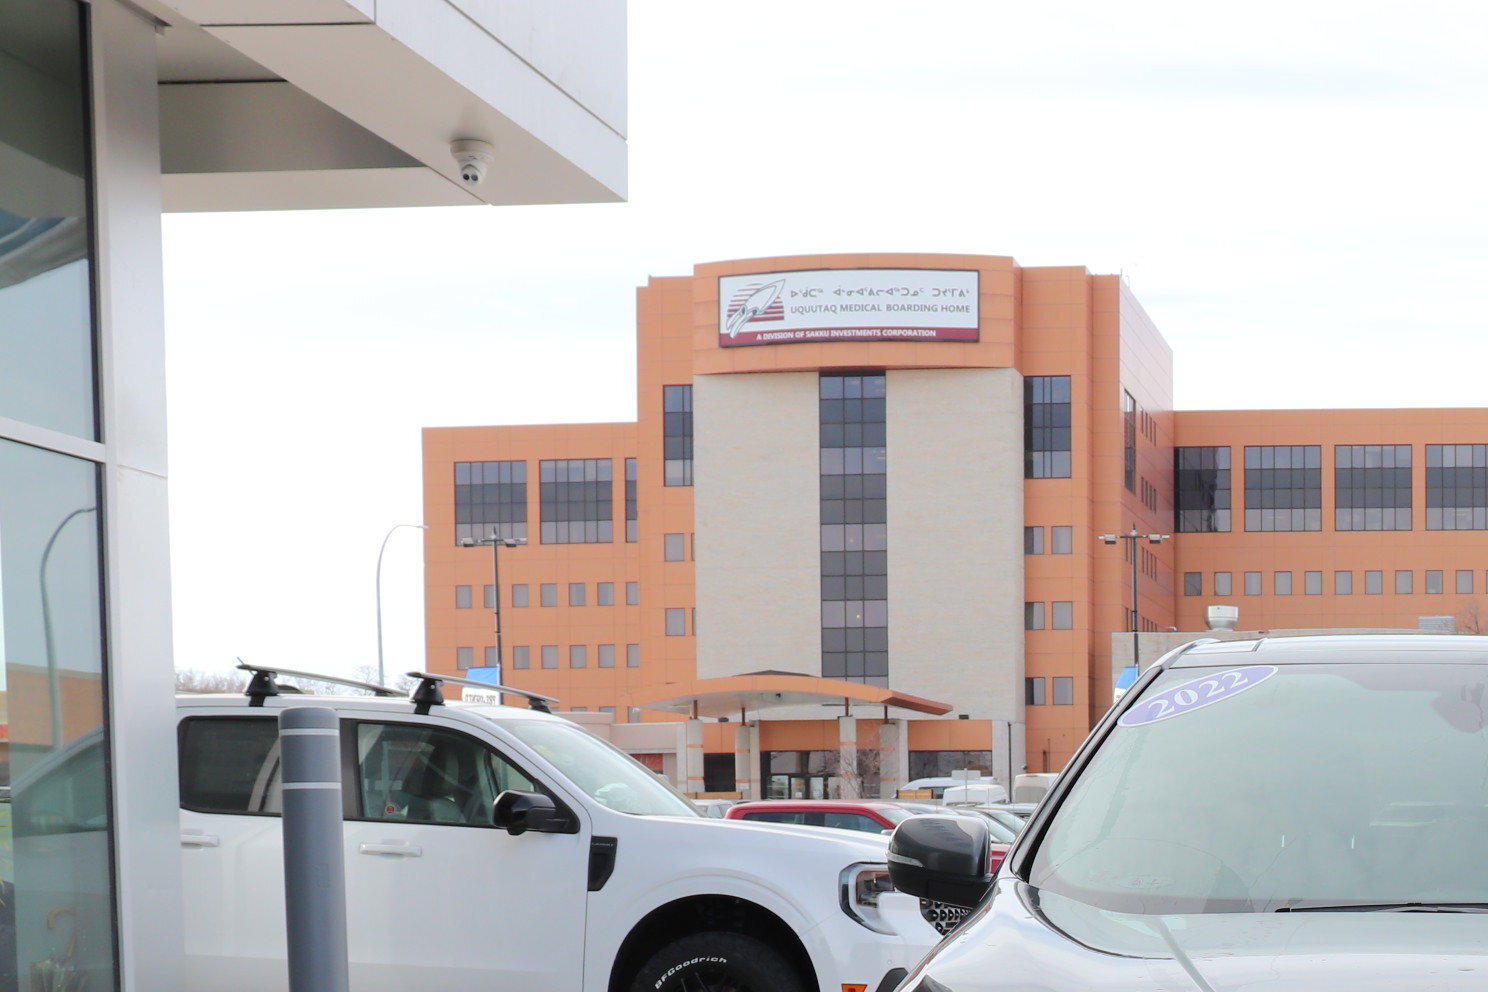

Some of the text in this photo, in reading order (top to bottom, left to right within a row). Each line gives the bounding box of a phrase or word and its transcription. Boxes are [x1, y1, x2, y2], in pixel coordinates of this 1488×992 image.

[790, 304, 970, 315] UQUUTAQ MEDICAL BOARDING HOME
[763, 331, 794, 340] DIVISION
[831, 329, 881, 337] INVESTMENTS
[882, 329, 936, 337] CORPORATION
[1148, 671, 1248, 718] 2022
[655, 956, 728, 990] BFGoodrich
